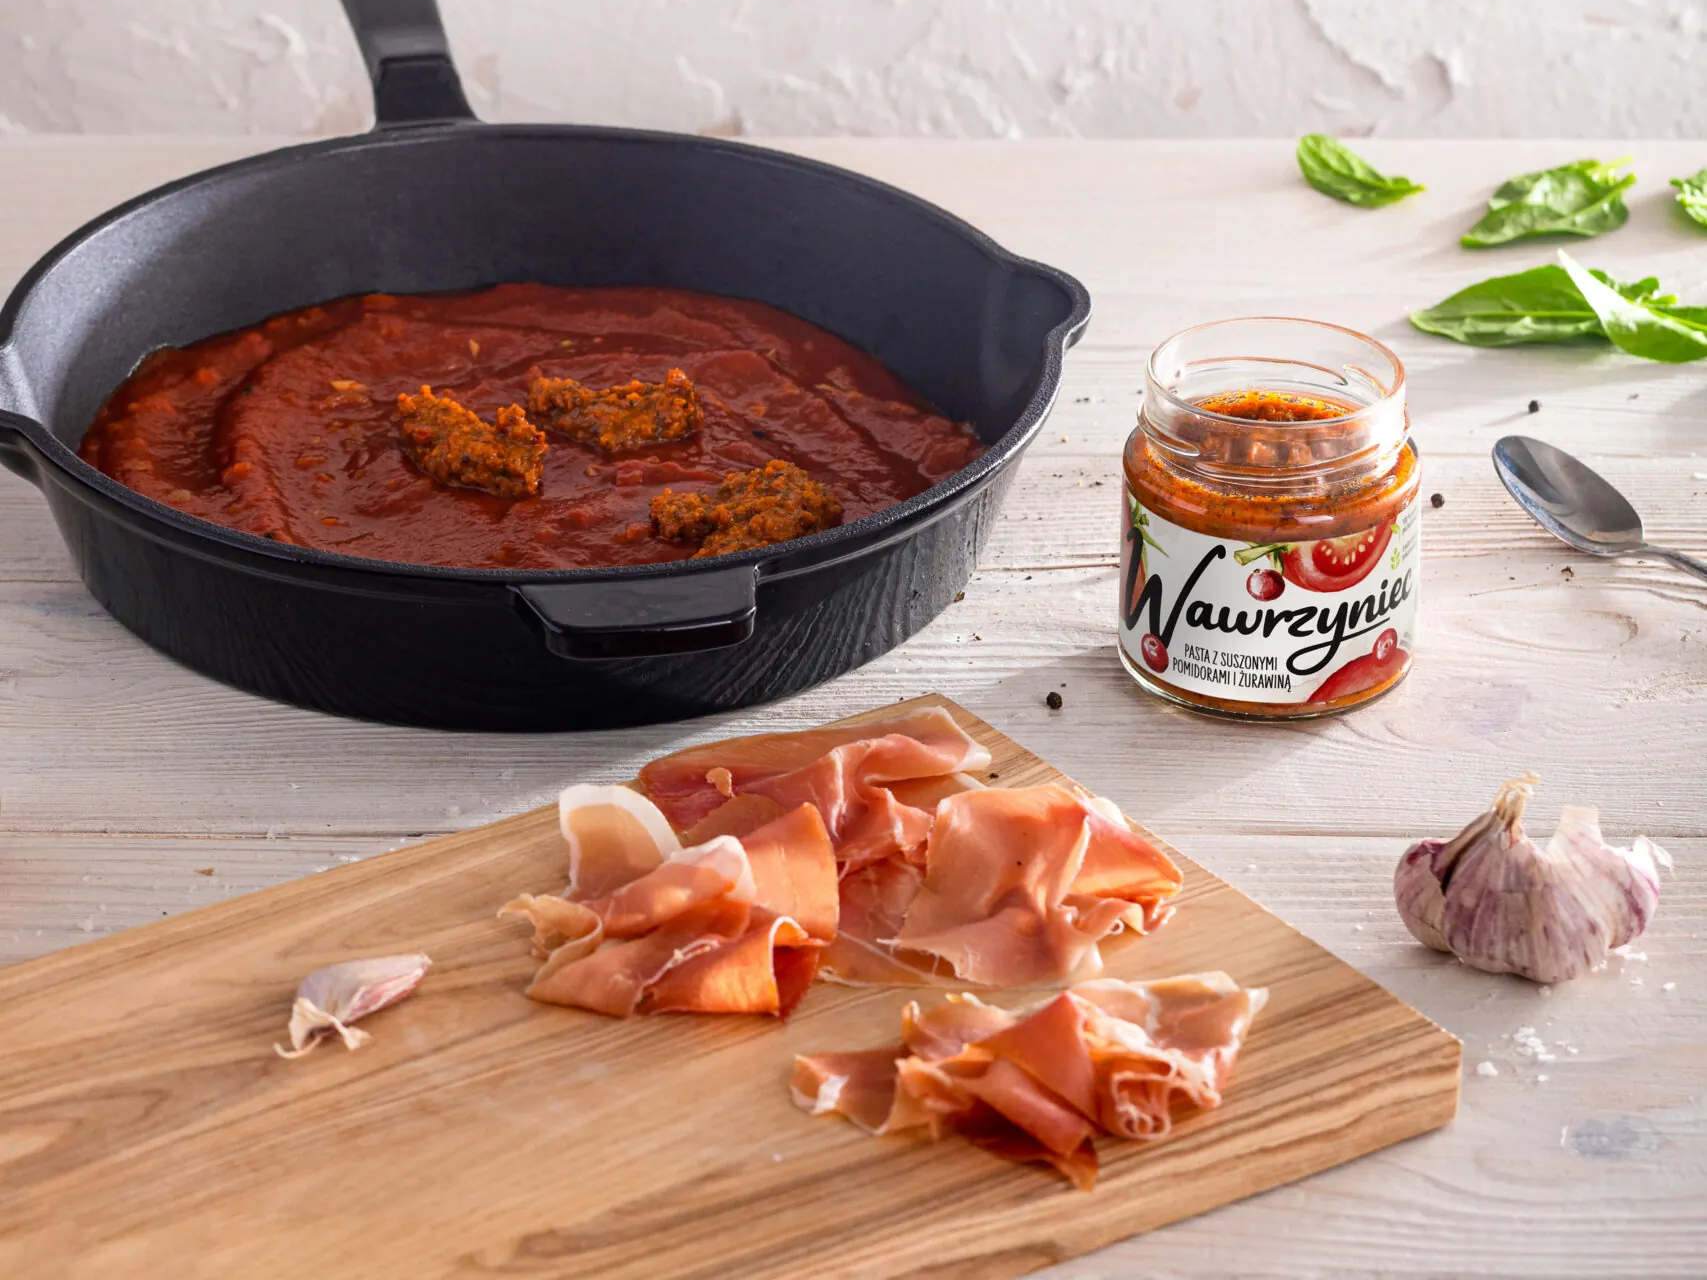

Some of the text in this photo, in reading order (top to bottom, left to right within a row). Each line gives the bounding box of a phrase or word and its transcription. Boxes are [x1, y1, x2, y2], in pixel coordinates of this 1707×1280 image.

[1124, 526, 1413, 676] Wawrzyniec
[1172, 656, 1231, 686] POMIDORAMI
[1238, 670, 1292, 693] ŻURAWINĄ
[1184, 643, 1278, 671] PASTA Z SUSZONYMI
